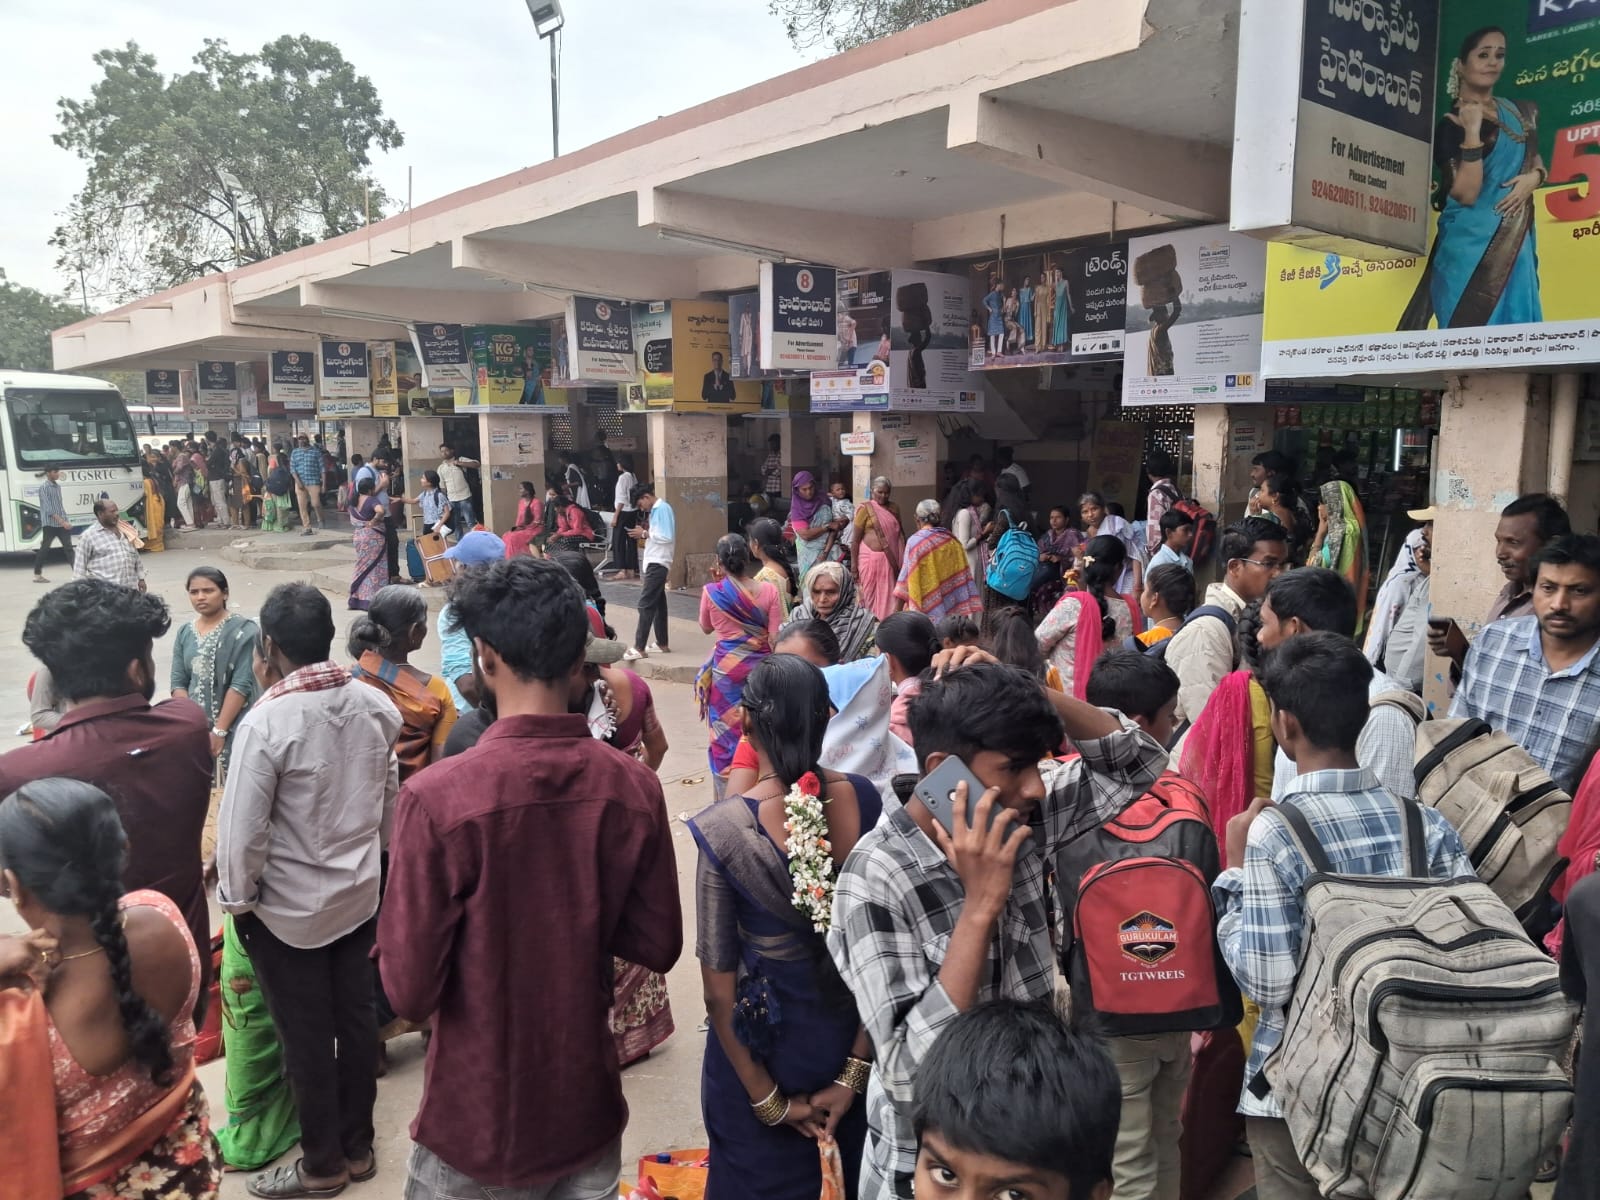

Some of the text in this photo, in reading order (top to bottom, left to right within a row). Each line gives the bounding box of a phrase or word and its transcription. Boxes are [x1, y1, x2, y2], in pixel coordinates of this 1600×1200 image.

[1317, 36, 1423, 115] హైదరాబాద్
[1515, 64, 1548, 85] మన
[1331, 137, 1405, 176] For Advertisement
[1349, 169, 1387, 190] Please Contact
[1085, 251, 1127, 277] ట్రెండ్స్
[1280, 267, 1296, 282] కేజీ
[1341, 263, 1363, 278] ఇచ్చే
[800, 273, 809, 288] 8
[598, 305, 608, 317] 9
[778, 296, 832, 315] హైదరాబాద్
[496, 343, 514, 355] KG
[1237, 375, 1252, 386] LIC
[68, 470, 117, 482] TGSRTC
[1120, 932, 1177, 943] GURUKULAM
[1119, 970, 1185, 982] TGTWREIS
